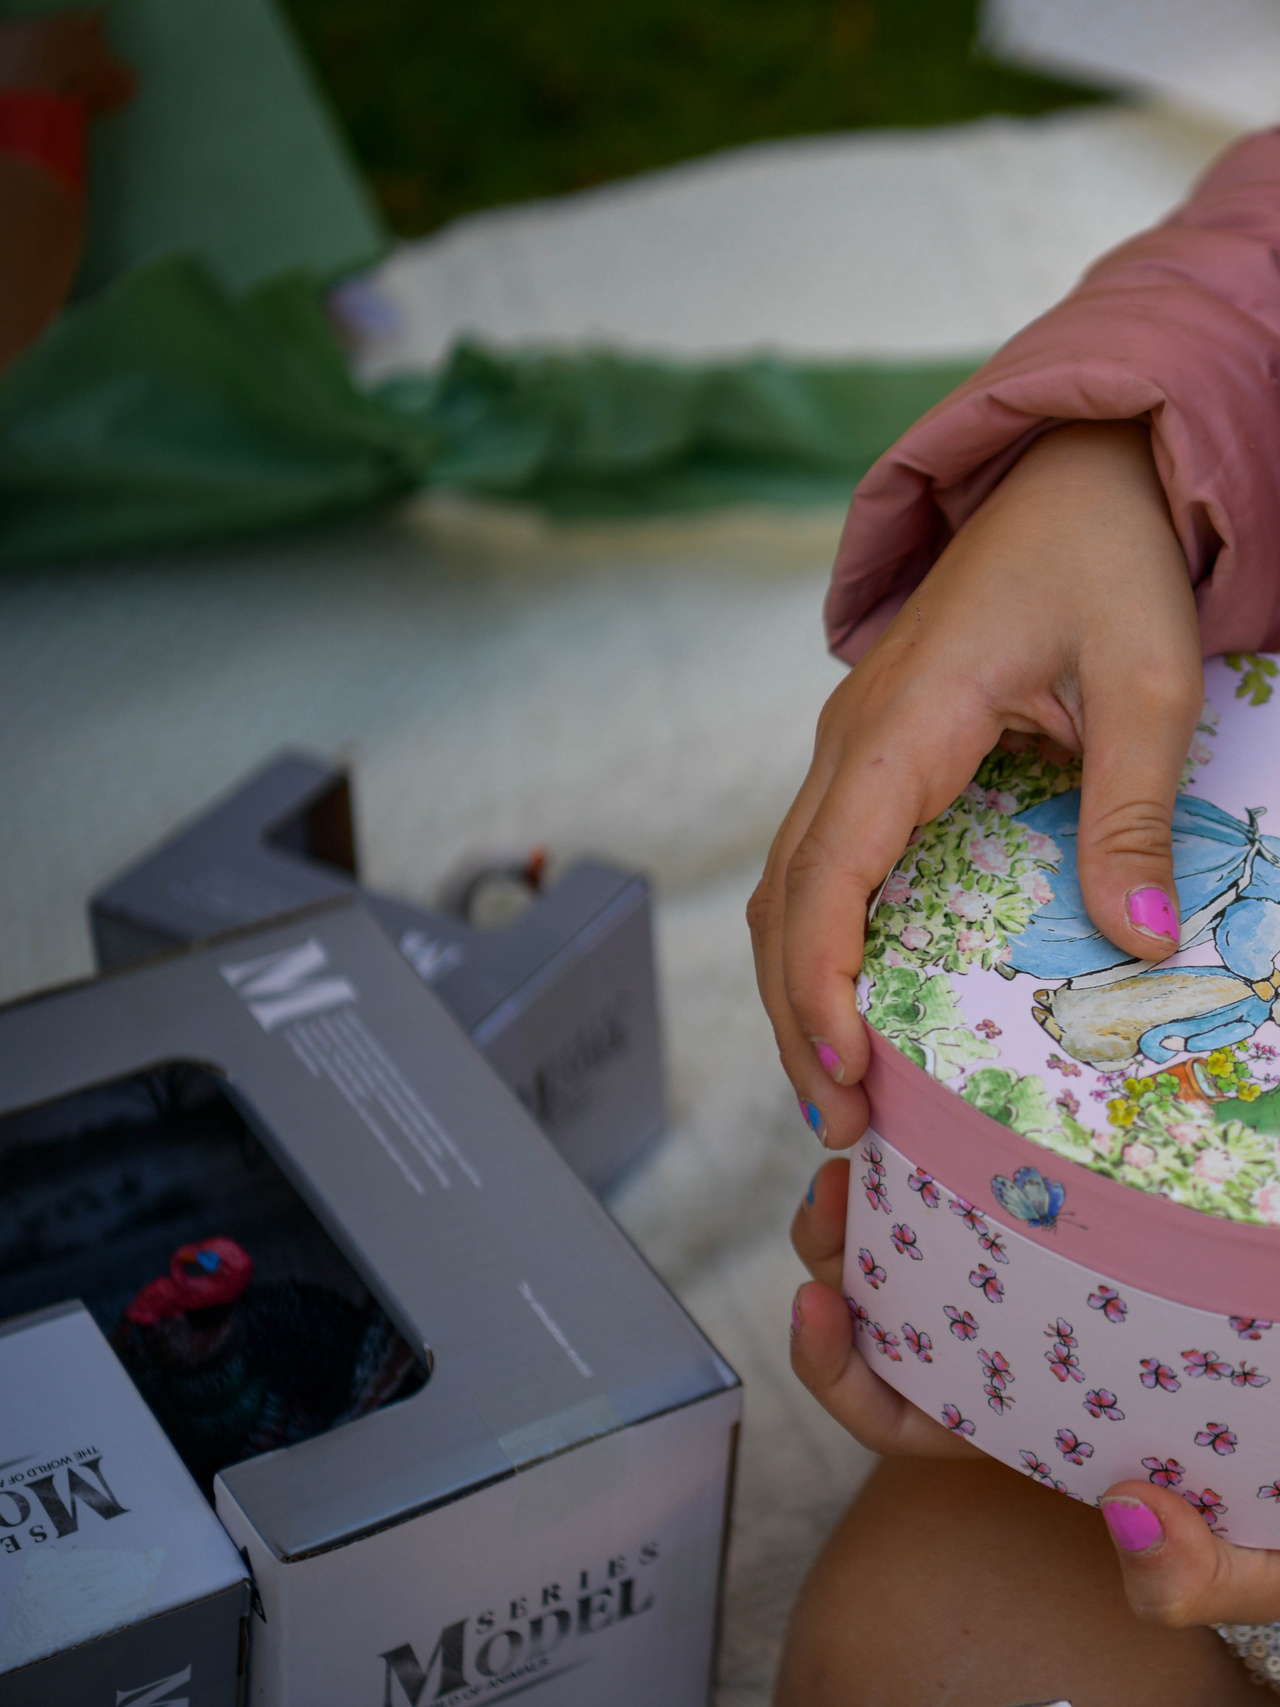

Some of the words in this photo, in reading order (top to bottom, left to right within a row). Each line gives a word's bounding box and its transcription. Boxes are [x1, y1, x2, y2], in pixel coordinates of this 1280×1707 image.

[73, 1446, 99, 1460] THE
[27, 1456, 72, 1477] WORLD
[8, 1473, 24, 1485] OF
[475, 1543, 659, 1634] SERIES
[378, 1578, 655, 1707] MODEL
